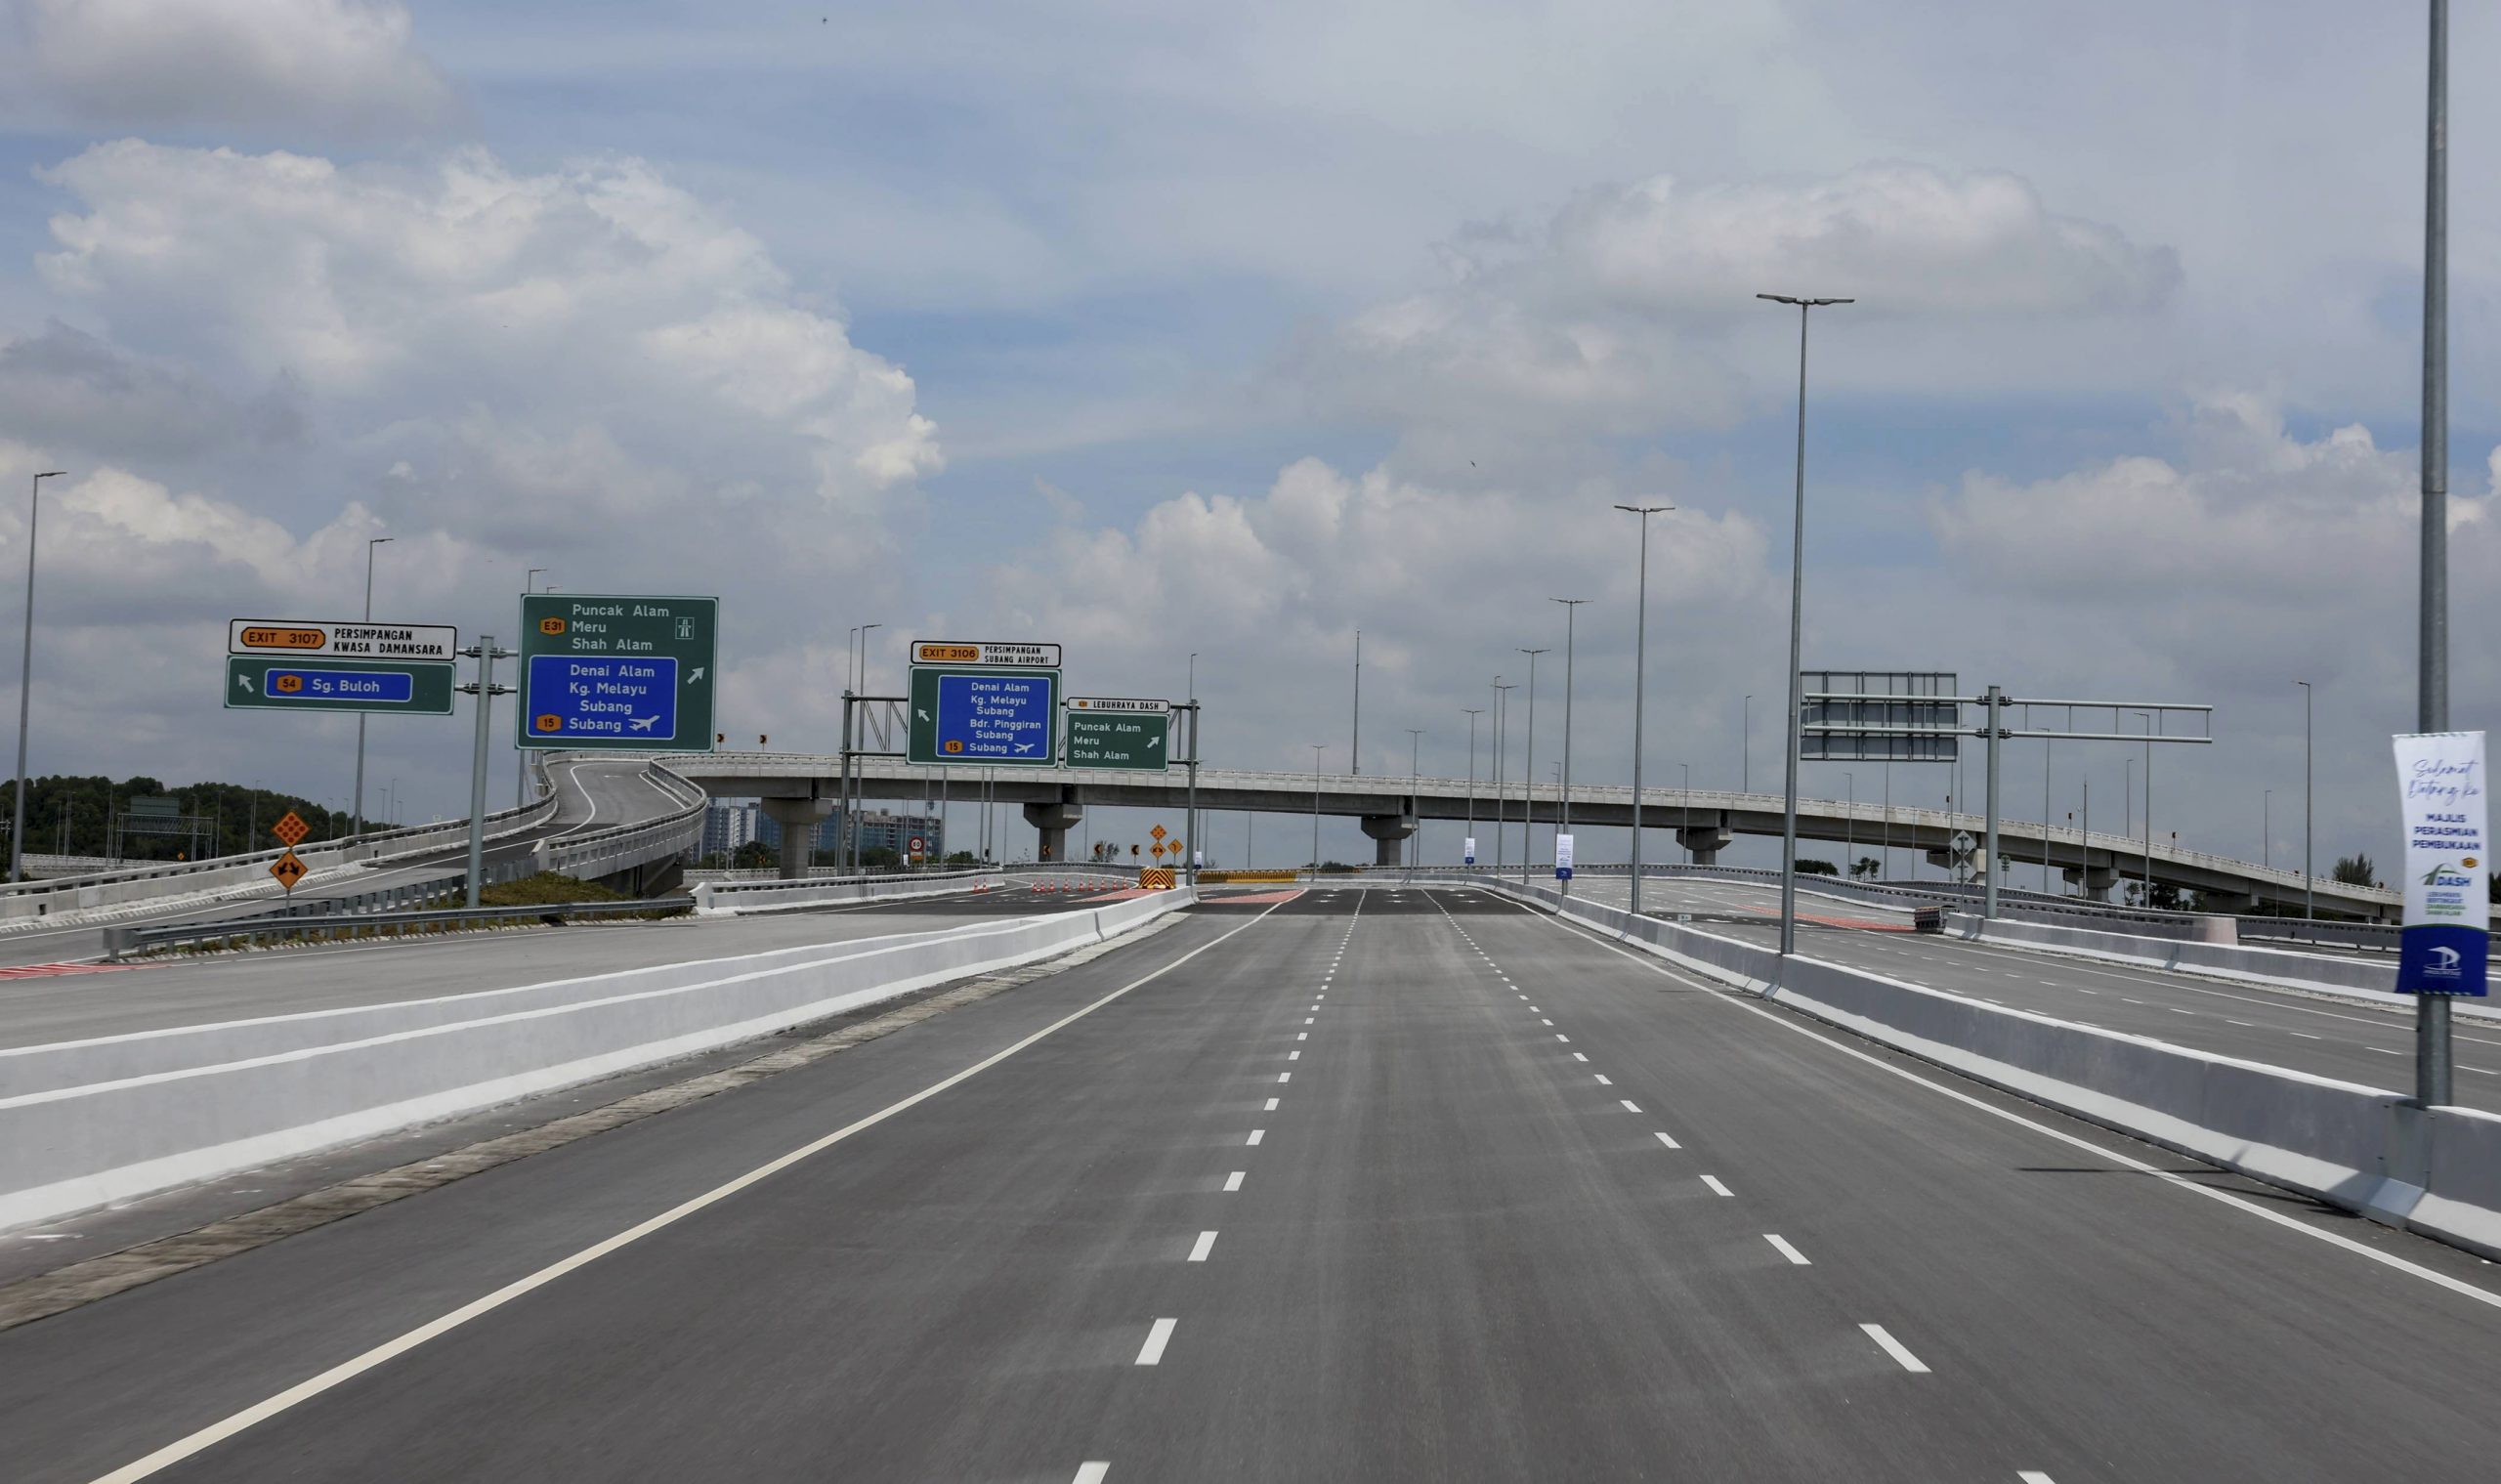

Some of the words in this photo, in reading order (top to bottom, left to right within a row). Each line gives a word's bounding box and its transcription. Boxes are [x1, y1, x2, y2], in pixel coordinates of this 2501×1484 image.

[572, 604, 624, 616] Puncak
[633, 605, 670, 617] Alam
[544, 621, 562, 631] E31
[572, 620, 607, 633] Meru
[248, 632, 277, 643] EXIT
[289, 633, 318, 645] 3107
[334, 628, 413, 641] PERSIMPANGAN
[333, 642, 371, 653] KWASA
[379, 643, 443, 656] DAMANSARA
[572, 637, 607, 650] Shah
[615, 638, 653, 651] Alam
[922, 649, 947, 657] EXIT
[951, 649, 976, 658] 3106
[985, 646, 1041, 655] PERSIMPANGAN
[985, 655, 1014, 663] SUBANG
[1018, 656, 1048, 664] AIRPORT
[570, 664, 610, 677] Denai
[618, 665, 656, 677] Alam
[282, 679, 296, 688] 54
[313, 678, 334, 693] Sg.
[339, 680, 380, 693] Buloh
[971, 682, 999, 692] Denai
[1003, 683, 1030, 692] Alam
[570, 682, 591, 697] Kg.
[596, 683, 647, 697] Melayu
[971, 695, 987, 705] Kg.
[991, 696, 1027, 706] Melayu
[1093, 700, 1135, 709] LEBUHRAYA
[579, 700, 632, 715] Subang
[976, 706, 1014, 717] Subang
[543, 718, 555, 728] 15
[569, 717, 622, 733] Subang
[970, 718, 991, 728] Bdr.
[995, 719, 1041, 731] Pinggiran
[1075, 722, 1111, 732] Puncak
[1116, 723, 1141, 733] Alam
[975, 730, 1014, 742] Subang
[1074, 736, 1100, 745] Meru
[949, 742, 959, 751] 15
[969, 742, 1007, 754] Subang
[1074, 749, 1100, 759] Shah
[1103, 750, 1129, 760] Alam
[2414, 827, 2479, 837] PERASMIAN
[2412, 839, 2481, 851] PEMBUKAAN
